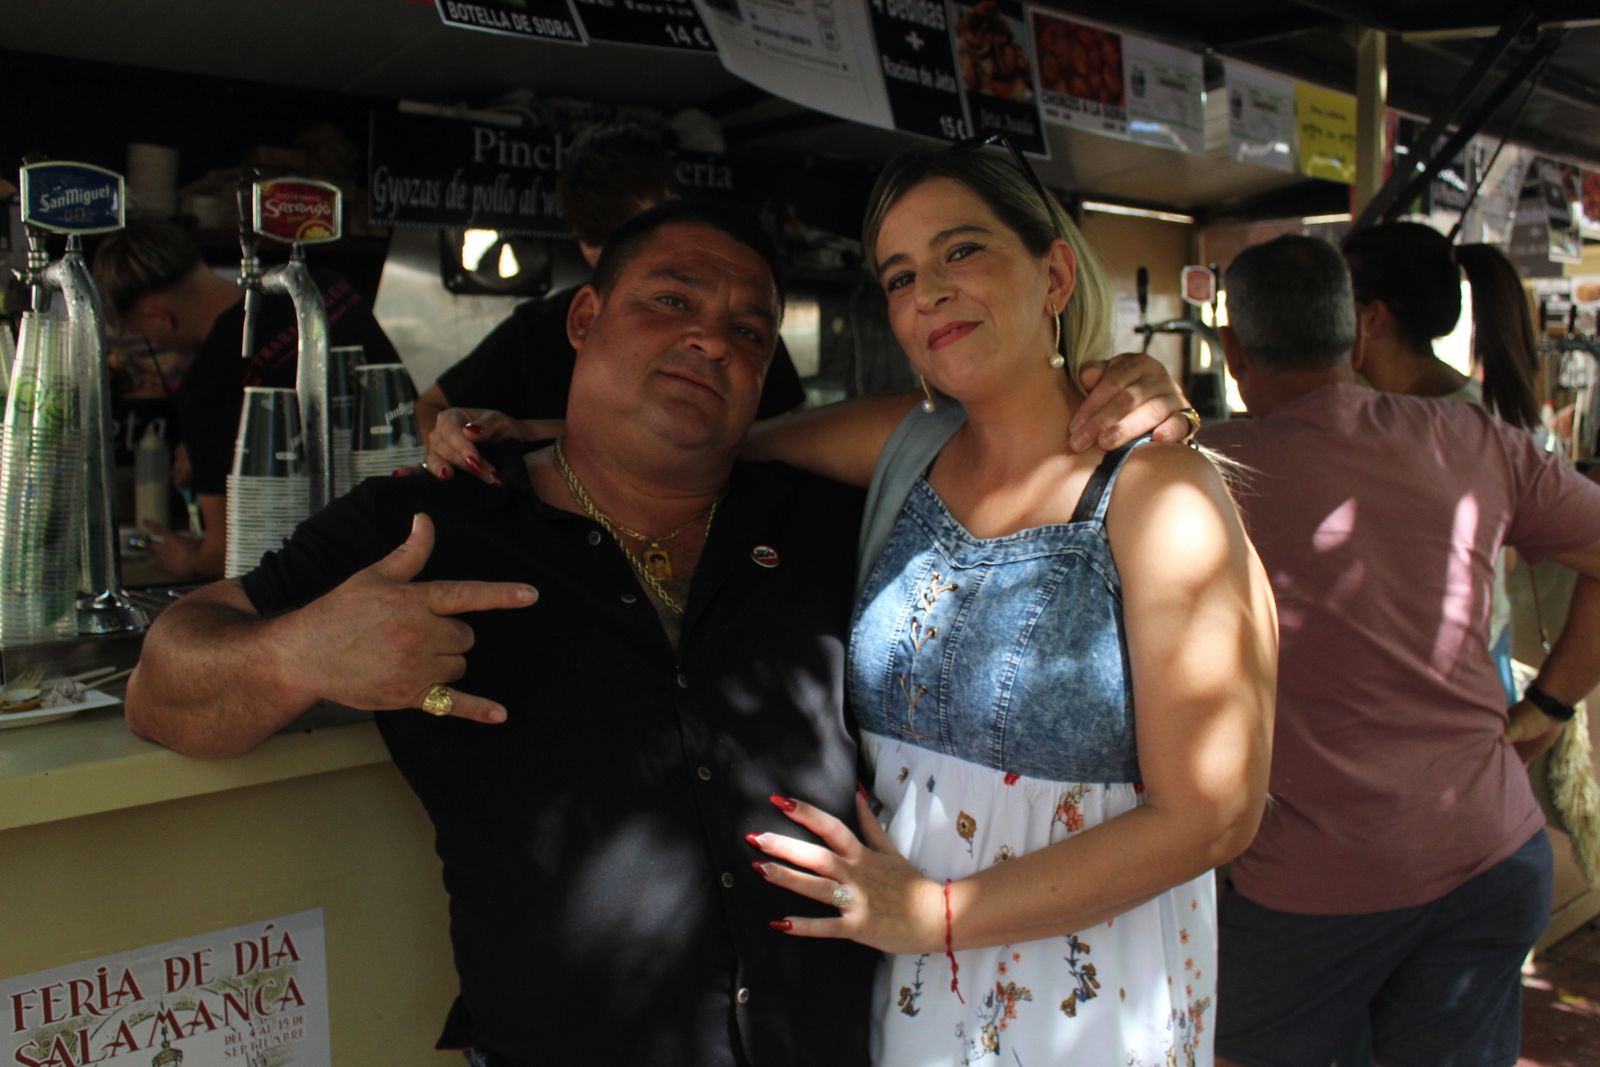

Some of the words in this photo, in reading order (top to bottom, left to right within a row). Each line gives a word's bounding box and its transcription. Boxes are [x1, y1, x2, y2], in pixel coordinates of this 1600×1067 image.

[447, 3, 512, 30] BOTELLA
[511, 12, 532, 33] DE
[532, 15, 576, 39] SIDRA
[665, 23, 692, 45] 14
[939, 114, 957, 139] 15
[372, 163, 443, 220] Gyozas
[445, 167, 467, 210] de
[467, 173, 515, 225] pollo
[10, 965, 144, 1034] FERIA
[163, 947, 216, 994] DE
[233, 923, 302, 977] DÍA
